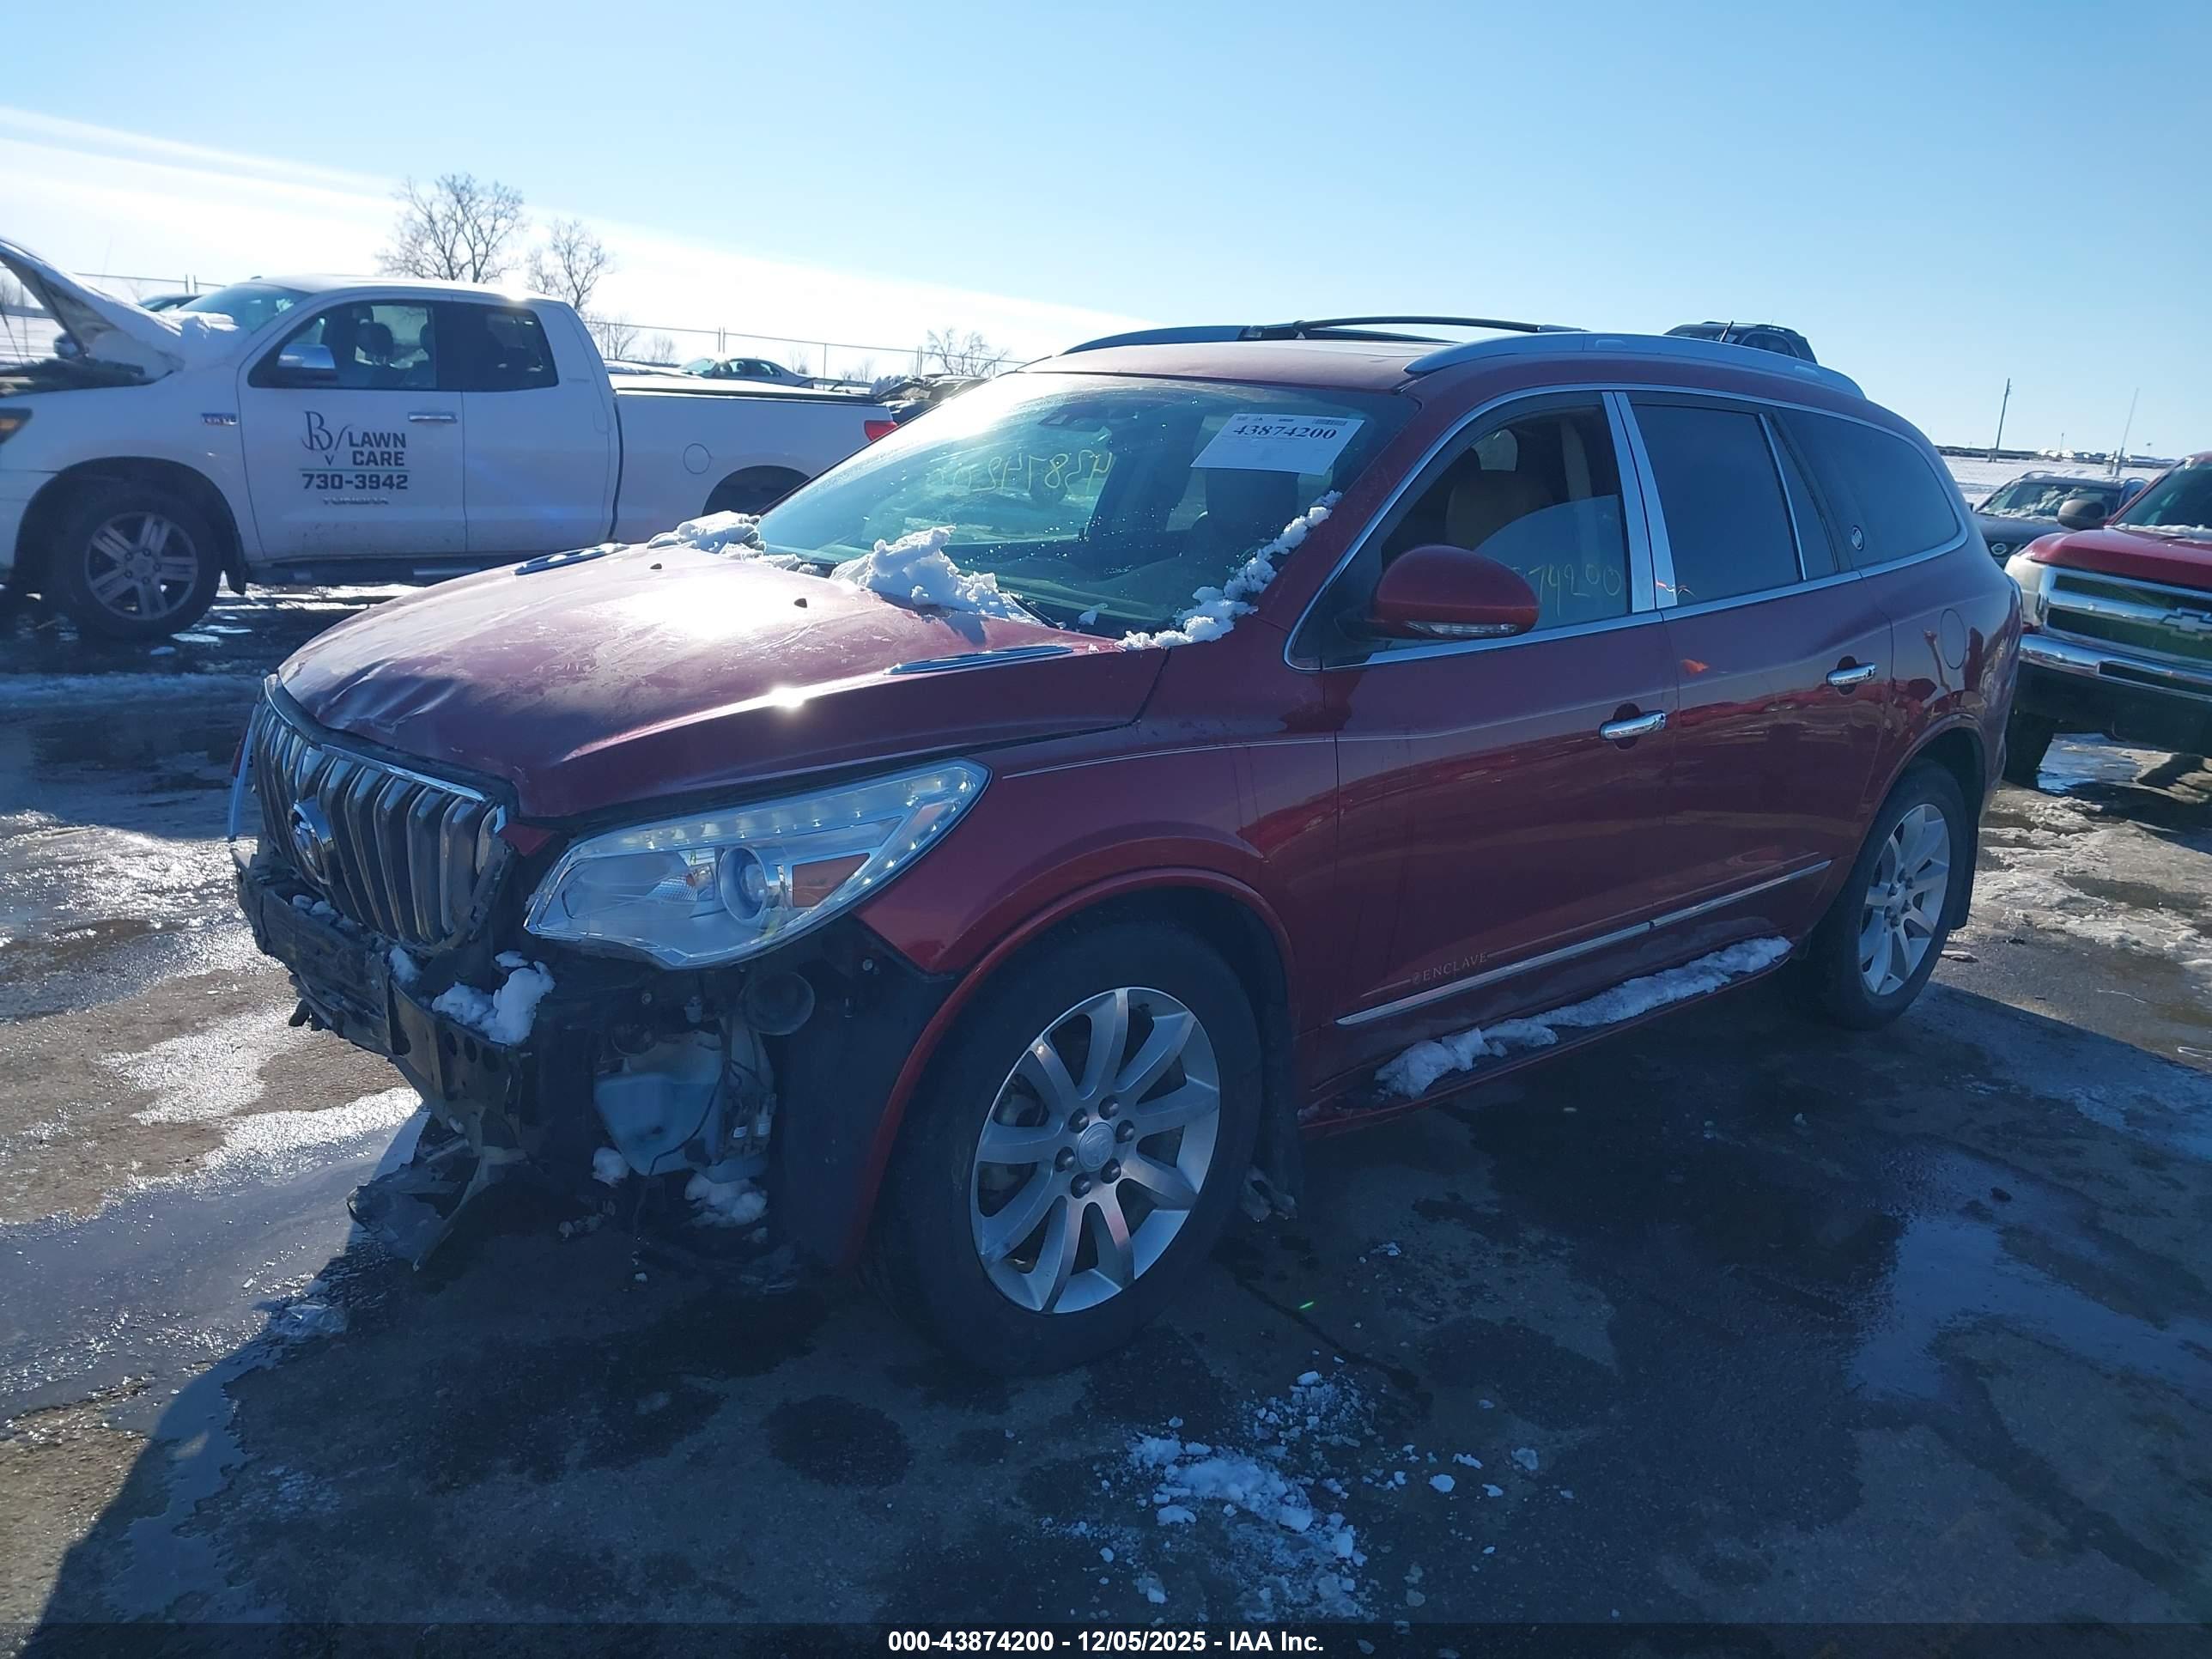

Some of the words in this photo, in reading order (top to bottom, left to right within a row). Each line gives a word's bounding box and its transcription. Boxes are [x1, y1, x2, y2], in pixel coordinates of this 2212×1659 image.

[348, 431, 407, 449] LAWN
[1233, 424, 1338, 441] 43874200
[352, 451, 404, 467] CARE
[302, 473, 409, 490] 730-3942
[1422, 951, 1488, 982] ENCLAVE
